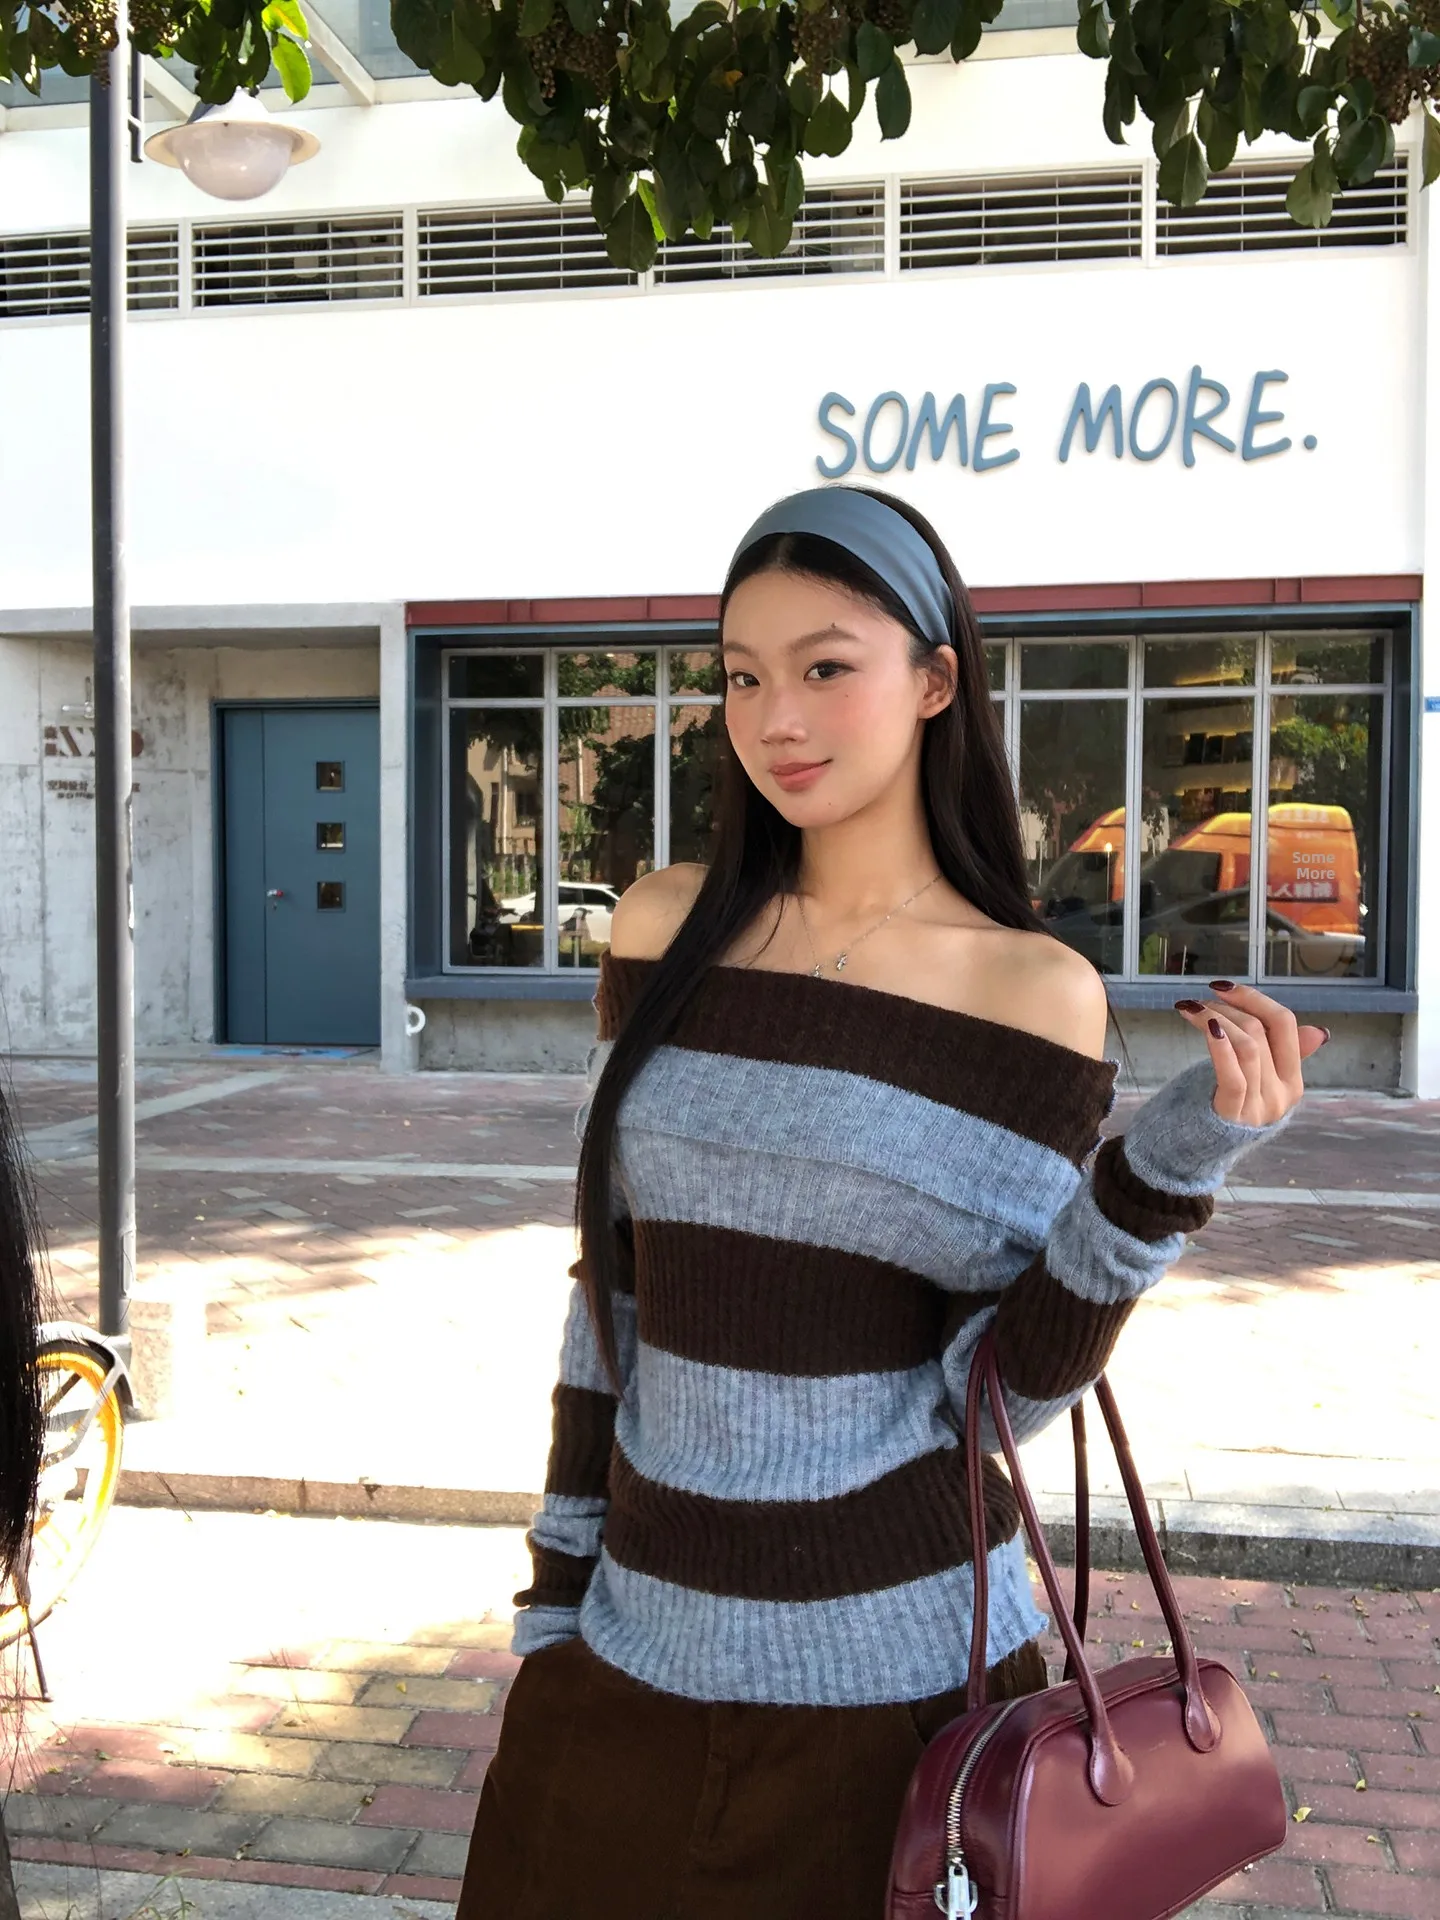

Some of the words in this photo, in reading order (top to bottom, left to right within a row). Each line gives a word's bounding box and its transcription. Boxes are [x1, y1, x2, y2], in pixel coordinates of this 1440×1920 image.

[816, 382, 1021, 479] SOME
[1058, 364, 1319, 468] MORE.
[1292, 851, 1336, 864] Some
[1296, 867, 1336, 880] More
